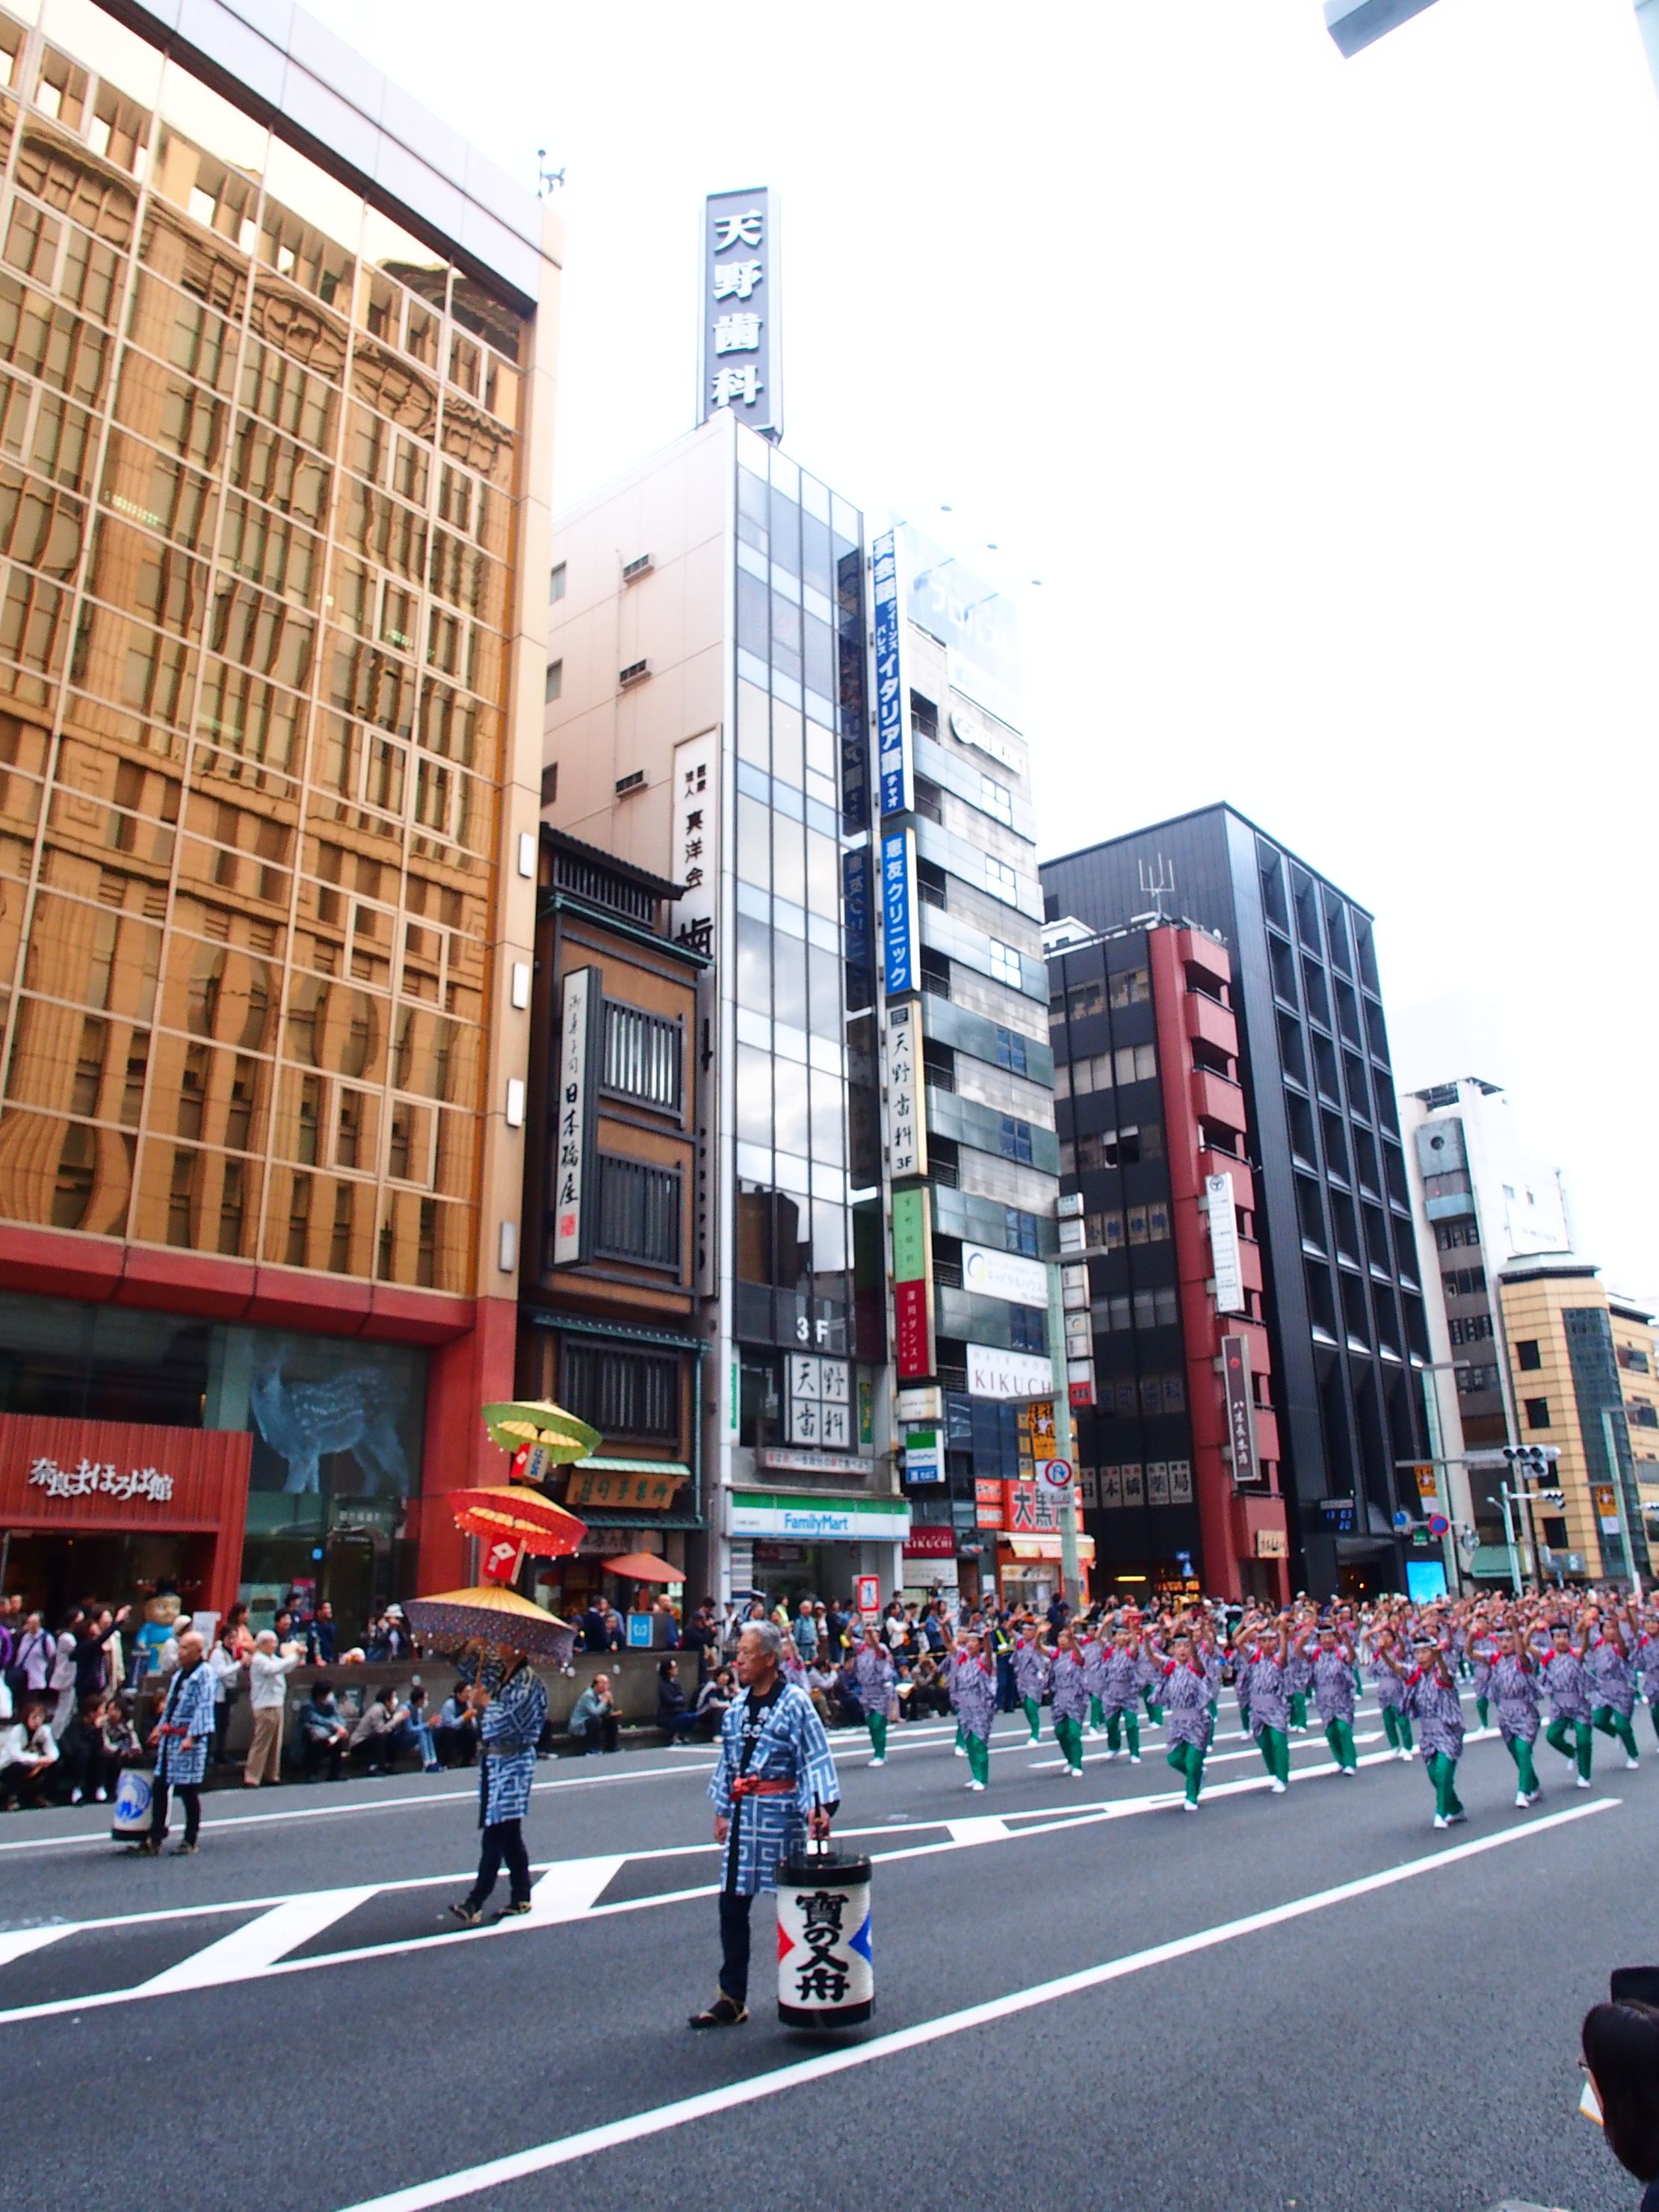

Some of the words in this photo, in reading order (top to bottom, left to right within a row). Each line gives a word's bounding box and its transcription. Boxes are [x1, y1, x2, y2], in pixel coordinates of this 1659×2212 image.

[711, 209, 763, 407] 天野歯科
[685, 809, 703, 891] 真洋会
[892, 1032, 911, 1148] 天野歯科
[560, 1083, 579, 1208] 日本橋屋
[897, 1156, 912, 1170] 3F
[797, 1362, 844, 1397] 天野
[974, 1368, 1051, 1395] KIKUCH
[1021, 1361, 1050, 1372] MOD
[796, 1403, 844, 1443] 歯科
[28, 1457, 174, 1501] 奈良まほろば館
[785, 1513, 848, 1534] FamilyMart
[1013, 1484, 1061, 1527] 大黒
